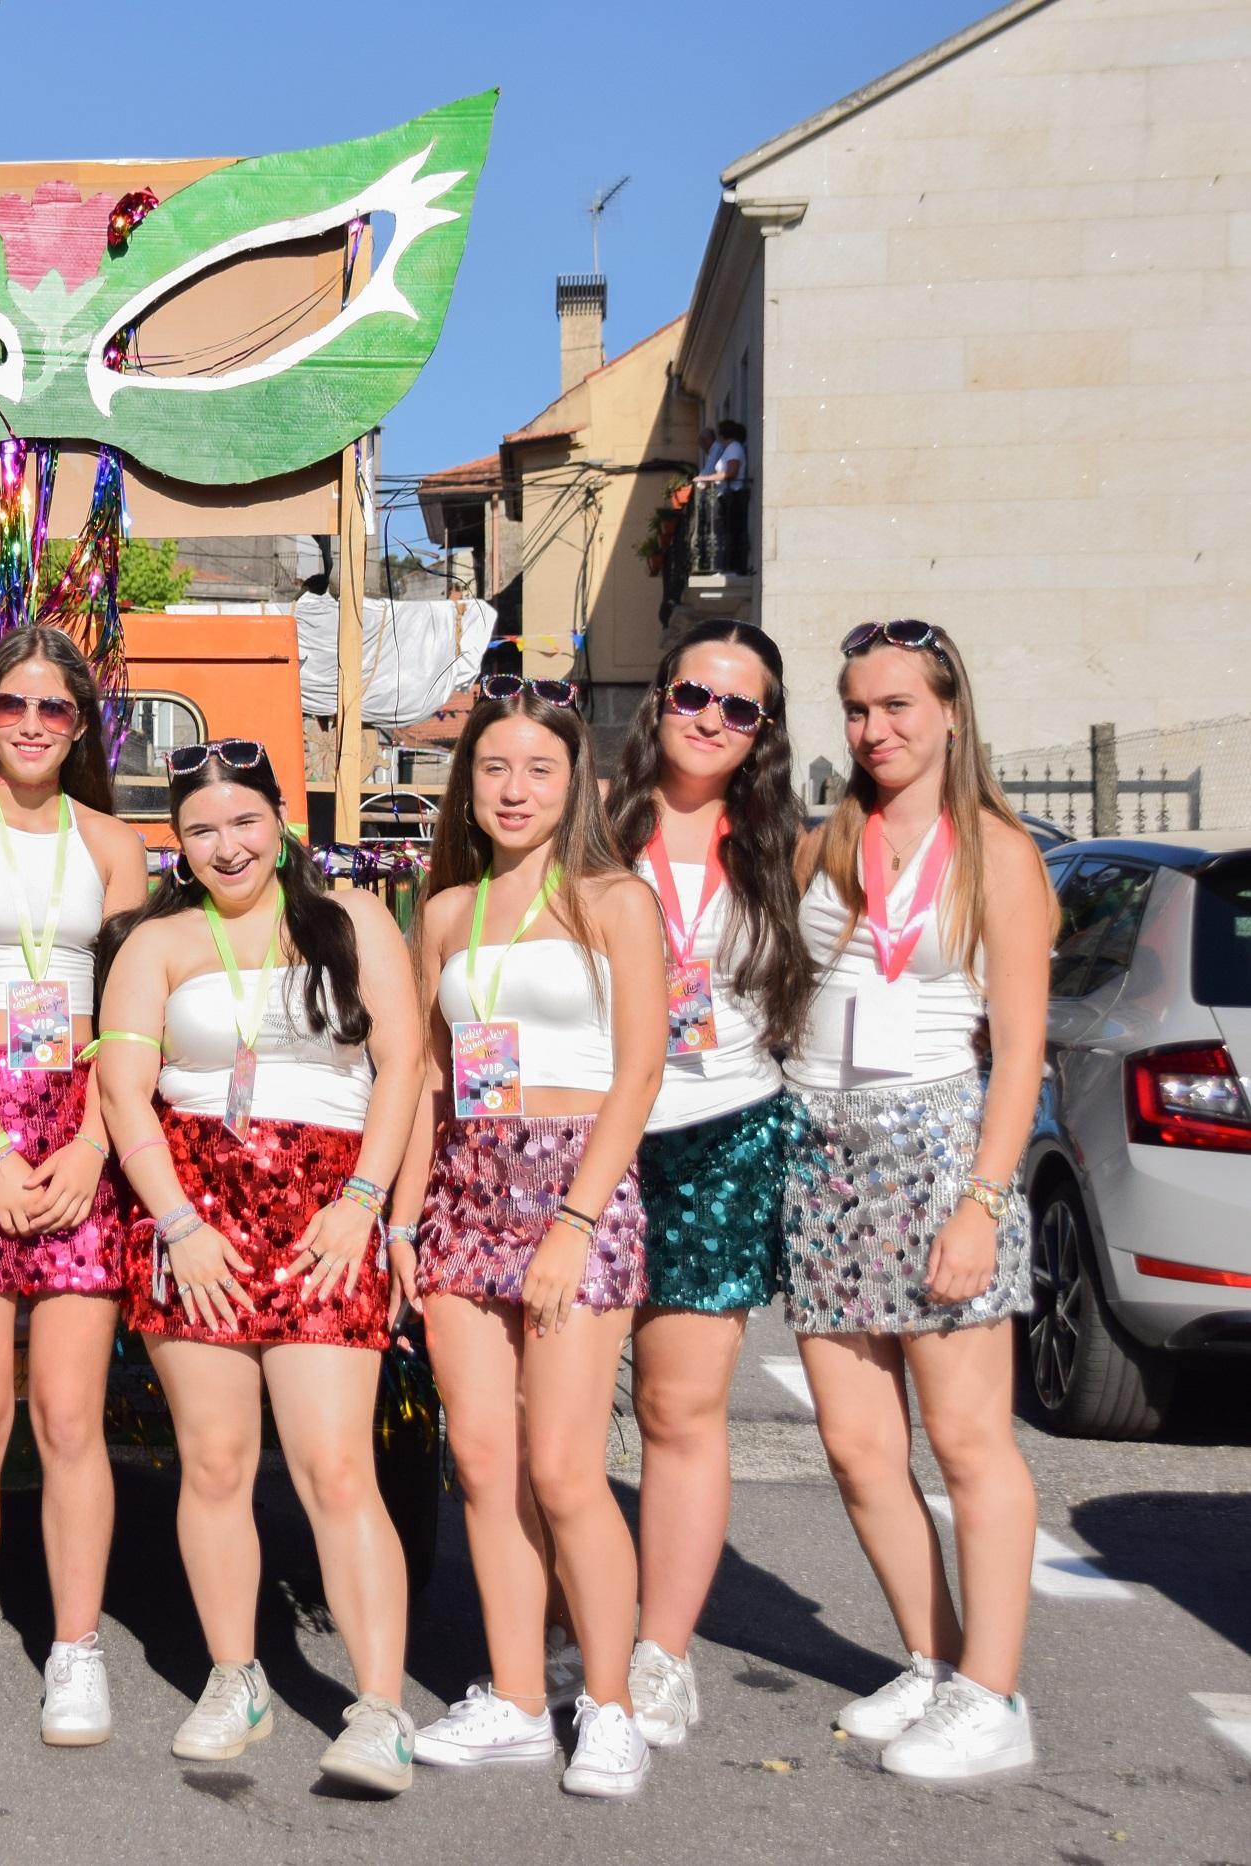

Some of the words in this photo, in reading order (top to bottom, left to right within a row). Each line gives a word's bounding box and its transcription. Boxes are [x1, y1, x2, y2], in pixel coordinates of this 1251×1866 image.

[678, 1001, 699, 1013] VIP
[31, 1018, 55, 1030] VIP
[479, 1063, 504, 1075] VIP
